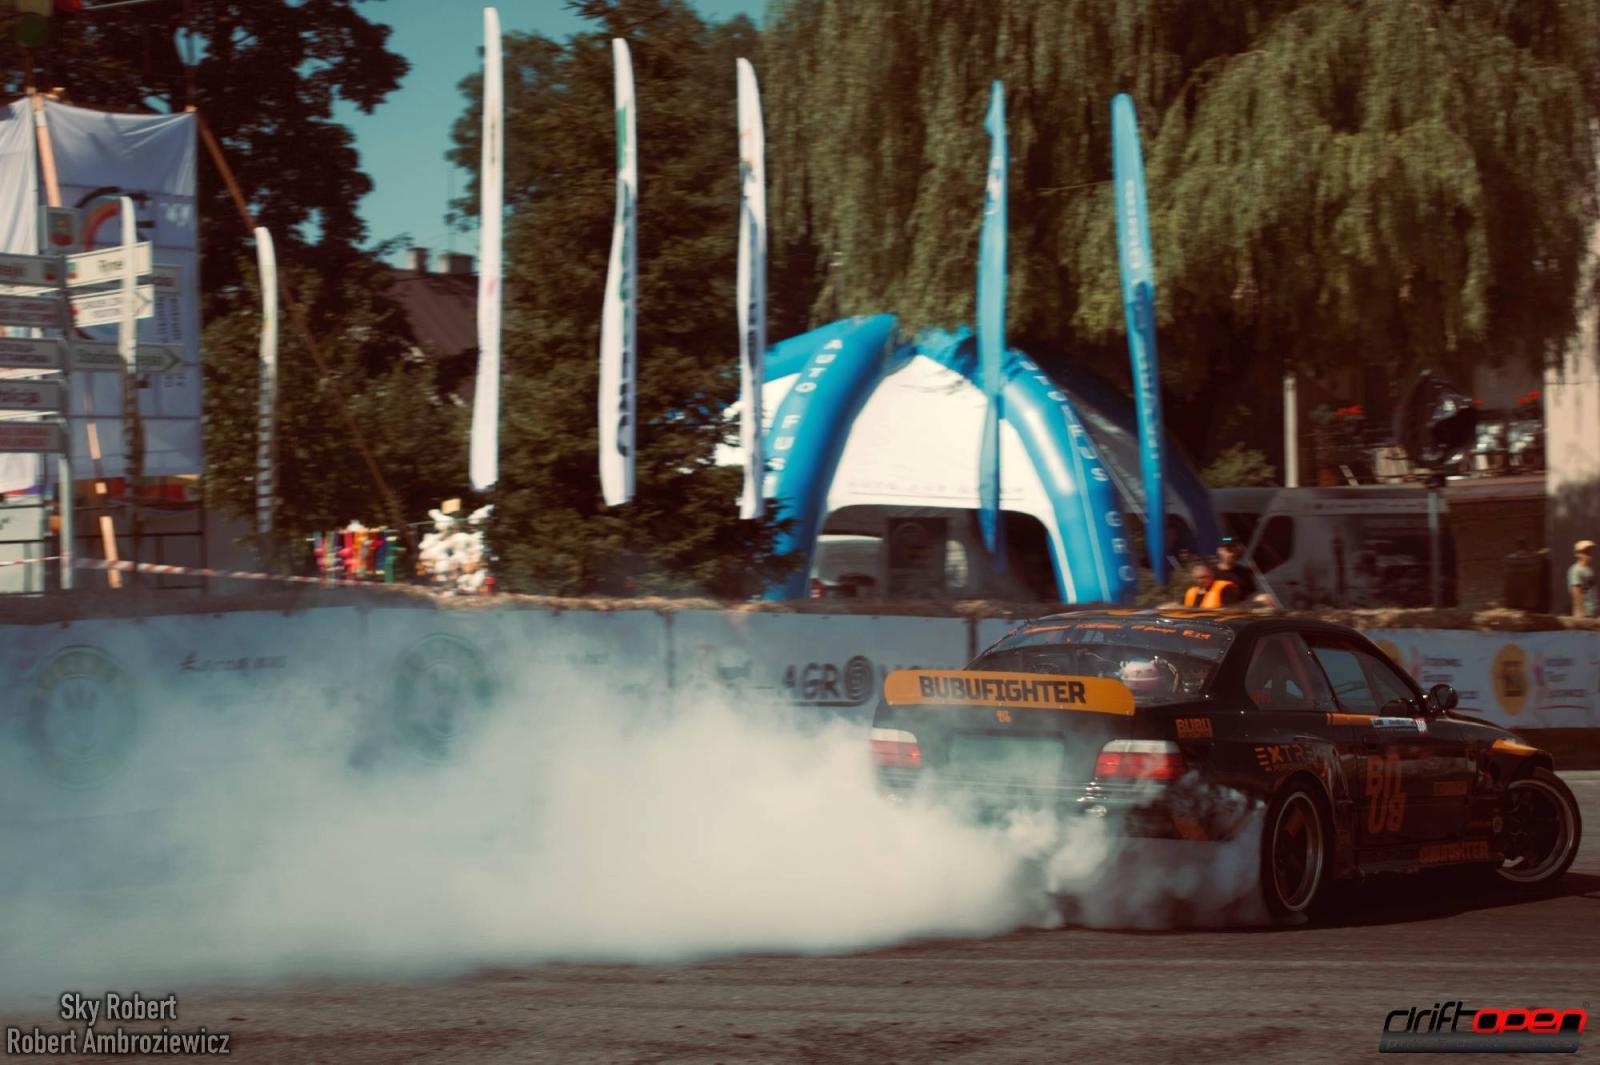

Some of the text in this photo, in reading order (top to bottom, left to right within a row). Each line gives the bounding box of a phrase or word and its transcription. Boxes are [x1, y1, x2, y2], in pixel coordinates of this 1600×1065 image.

[795, 338, 844, 393] AUTO
[918, 675, 1087, 705] BUBUFIGHTER
[1176, 718, 1212, 731] BUBU
